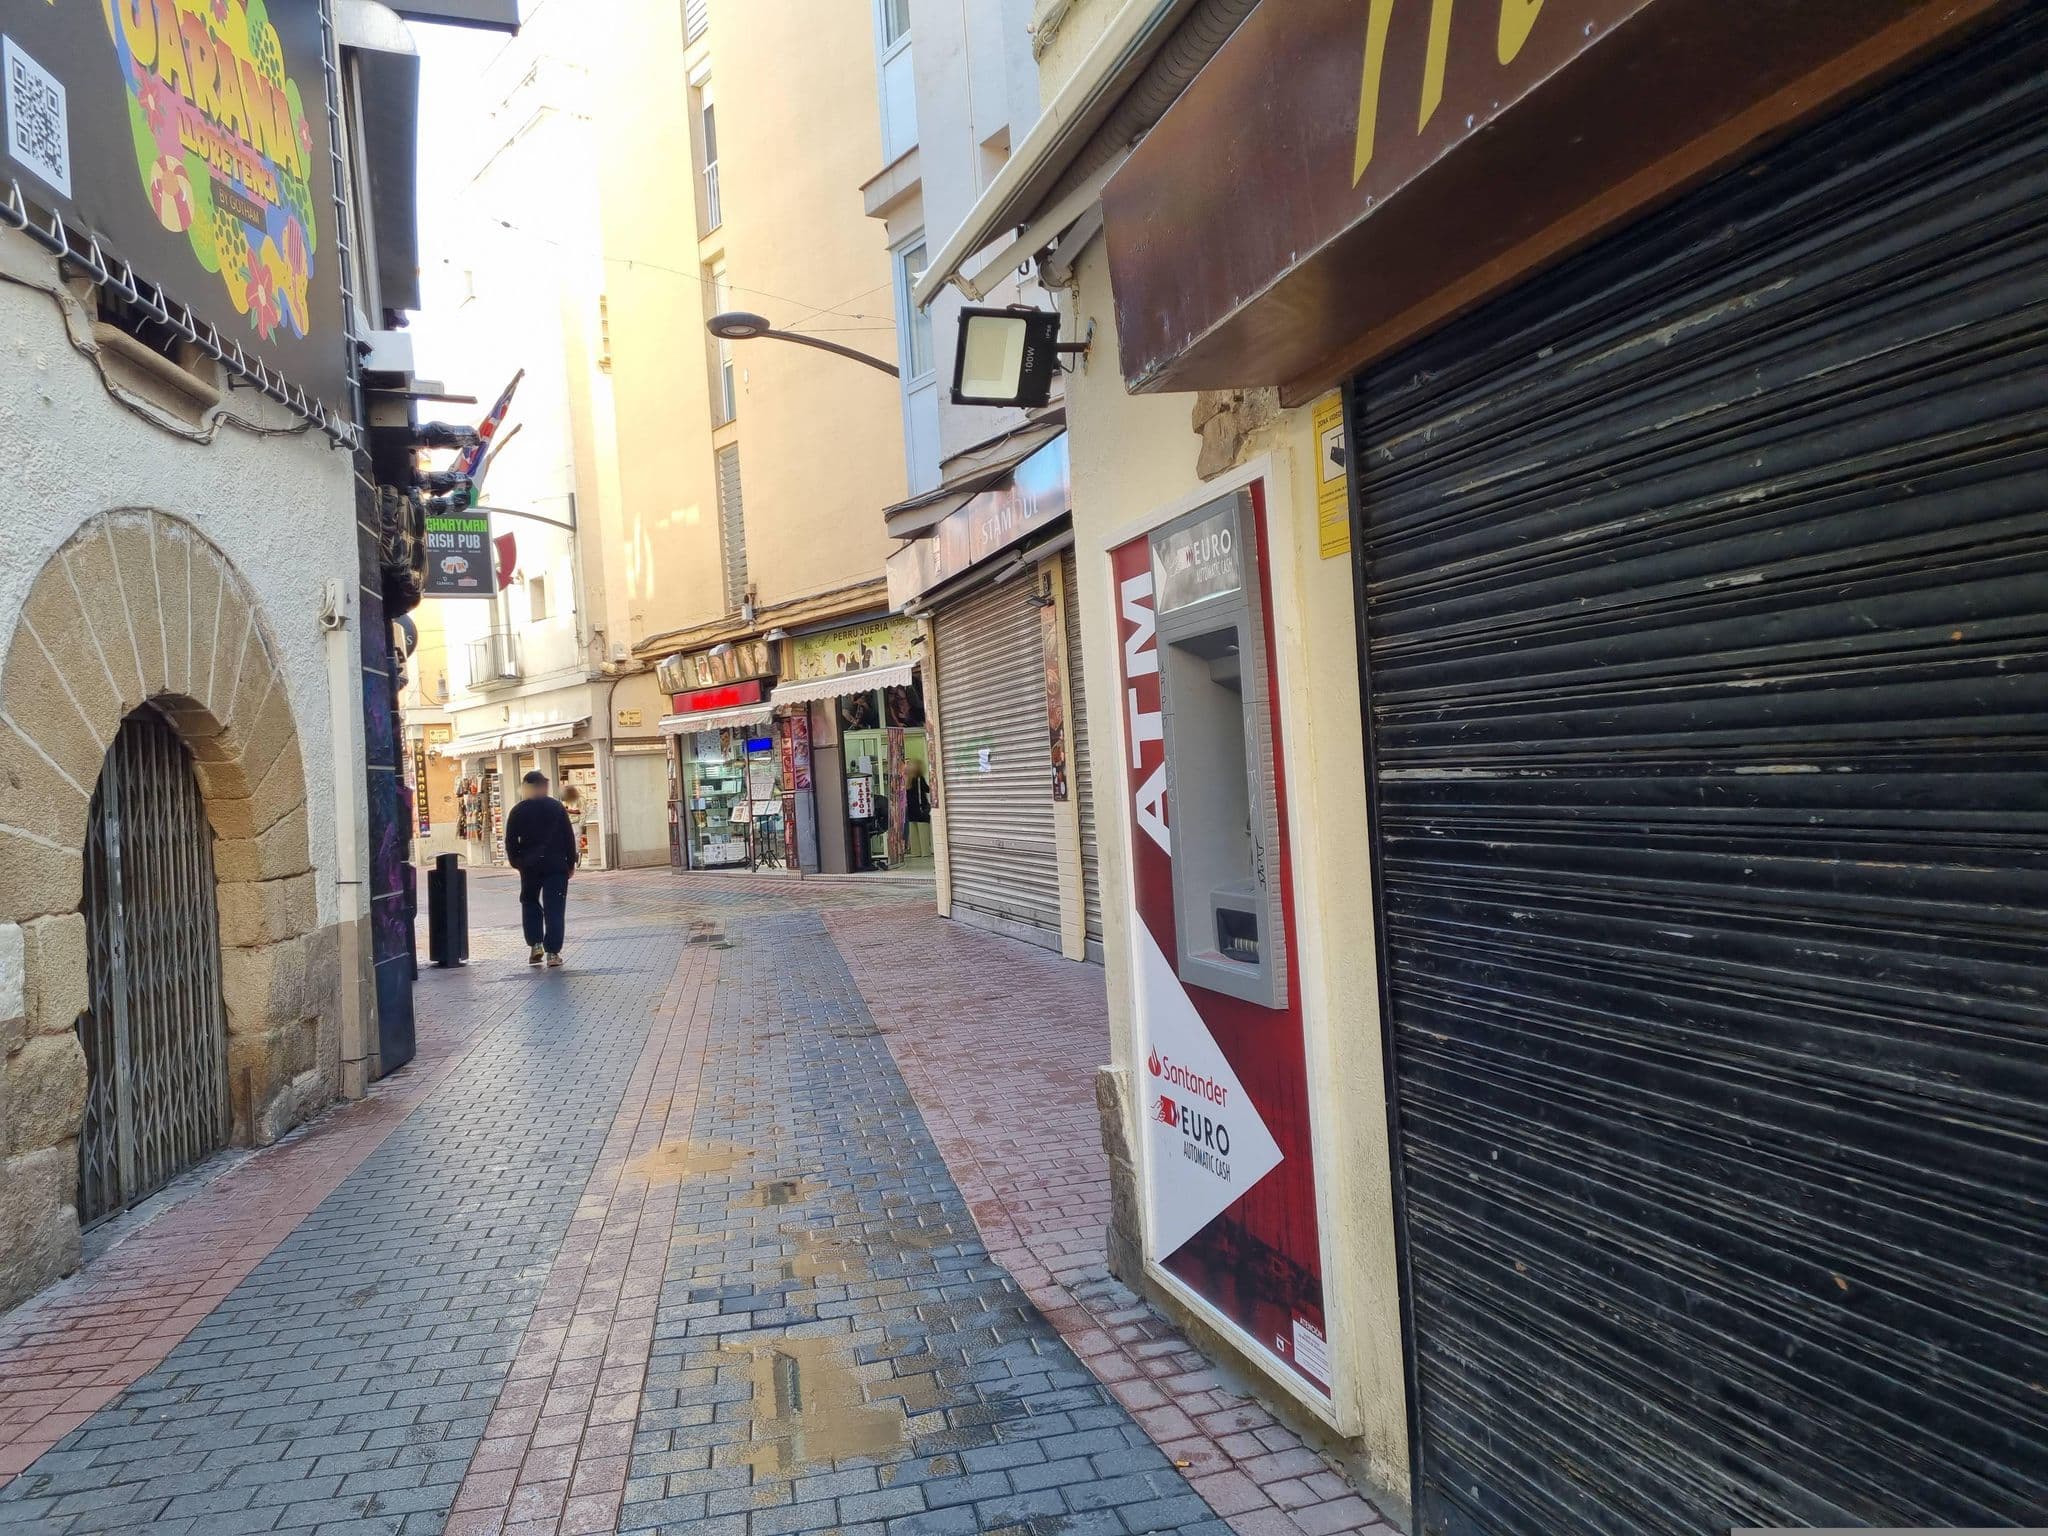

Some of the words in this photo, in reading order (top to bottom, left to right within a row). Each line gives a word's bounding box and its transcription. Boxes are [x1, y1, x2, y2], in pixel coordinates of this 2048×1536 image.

[1025, 346, 1035, 374] 100W
[459, 534, 480, 549] PUB
[1194, 529, 1231, 565] EURO
[1121, 571, 1172, 857] ATM
[416, 754, 427, 805] DIAMOND
[1163, 1056, 1228, 1108] Santander
[1181, 1105, 1230, 1156] EURO
[1183, 1141, 1215, 1174] AUTOMATIC
[1215, 1158, 1231, 1183] CASH
